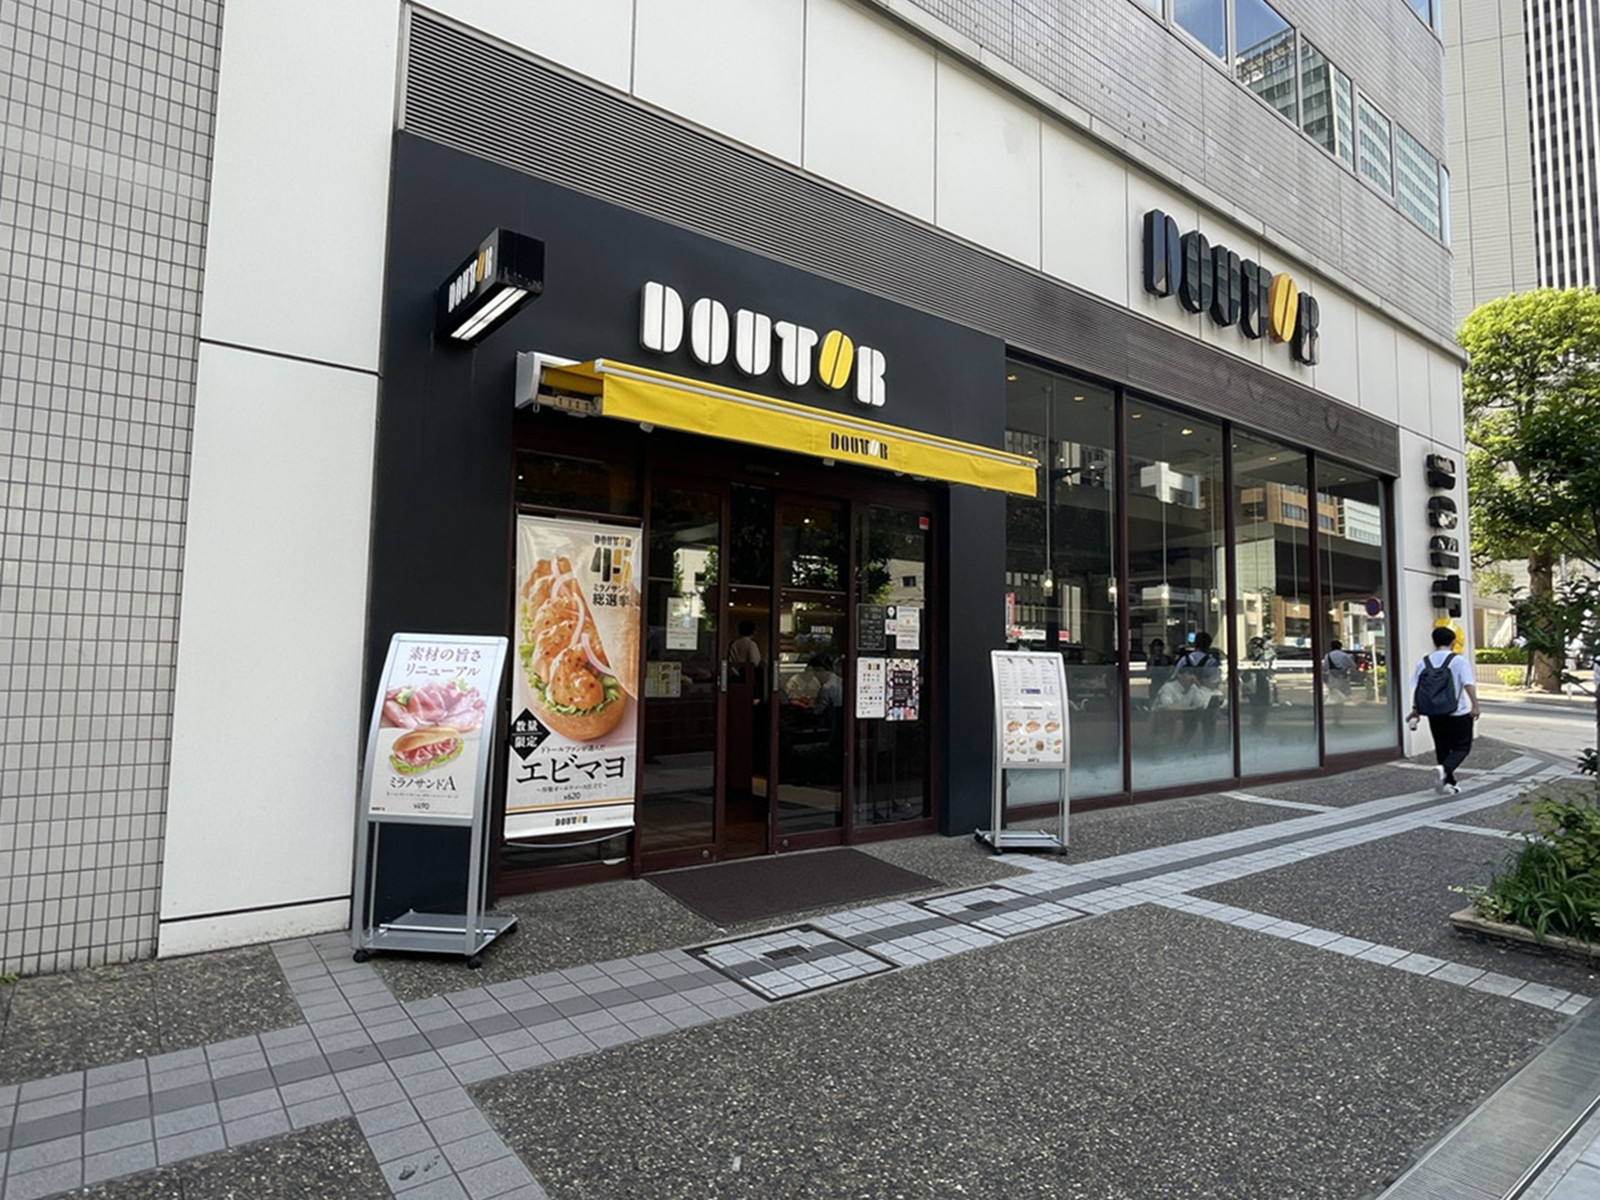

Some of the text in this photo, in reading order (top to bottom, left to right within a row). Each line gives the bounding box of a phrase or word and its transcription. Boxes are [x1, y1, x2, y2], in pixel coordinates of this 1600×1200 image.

[448, 246, 493, 313] DOUTOR
[1143, 208, 1320, 367] DOUTOR
[640, 280, 887, 407] DOUTOR
[830, 432, 888, 460] DOUTOR
[594, 535, 632, 547] DOUTOR
[409, 646, 482, 662] 素材の旨さ
[406, 663, 481, 677] リニューアル
[516, 720, 539, 732] 数量
[514, 736, 538, 748] 限定
[516, 754, 626, 784] エビマヨ
[389, 775, 456, 791] ミラノサンドA
[555, 815, 588, 826] DOUTOR
